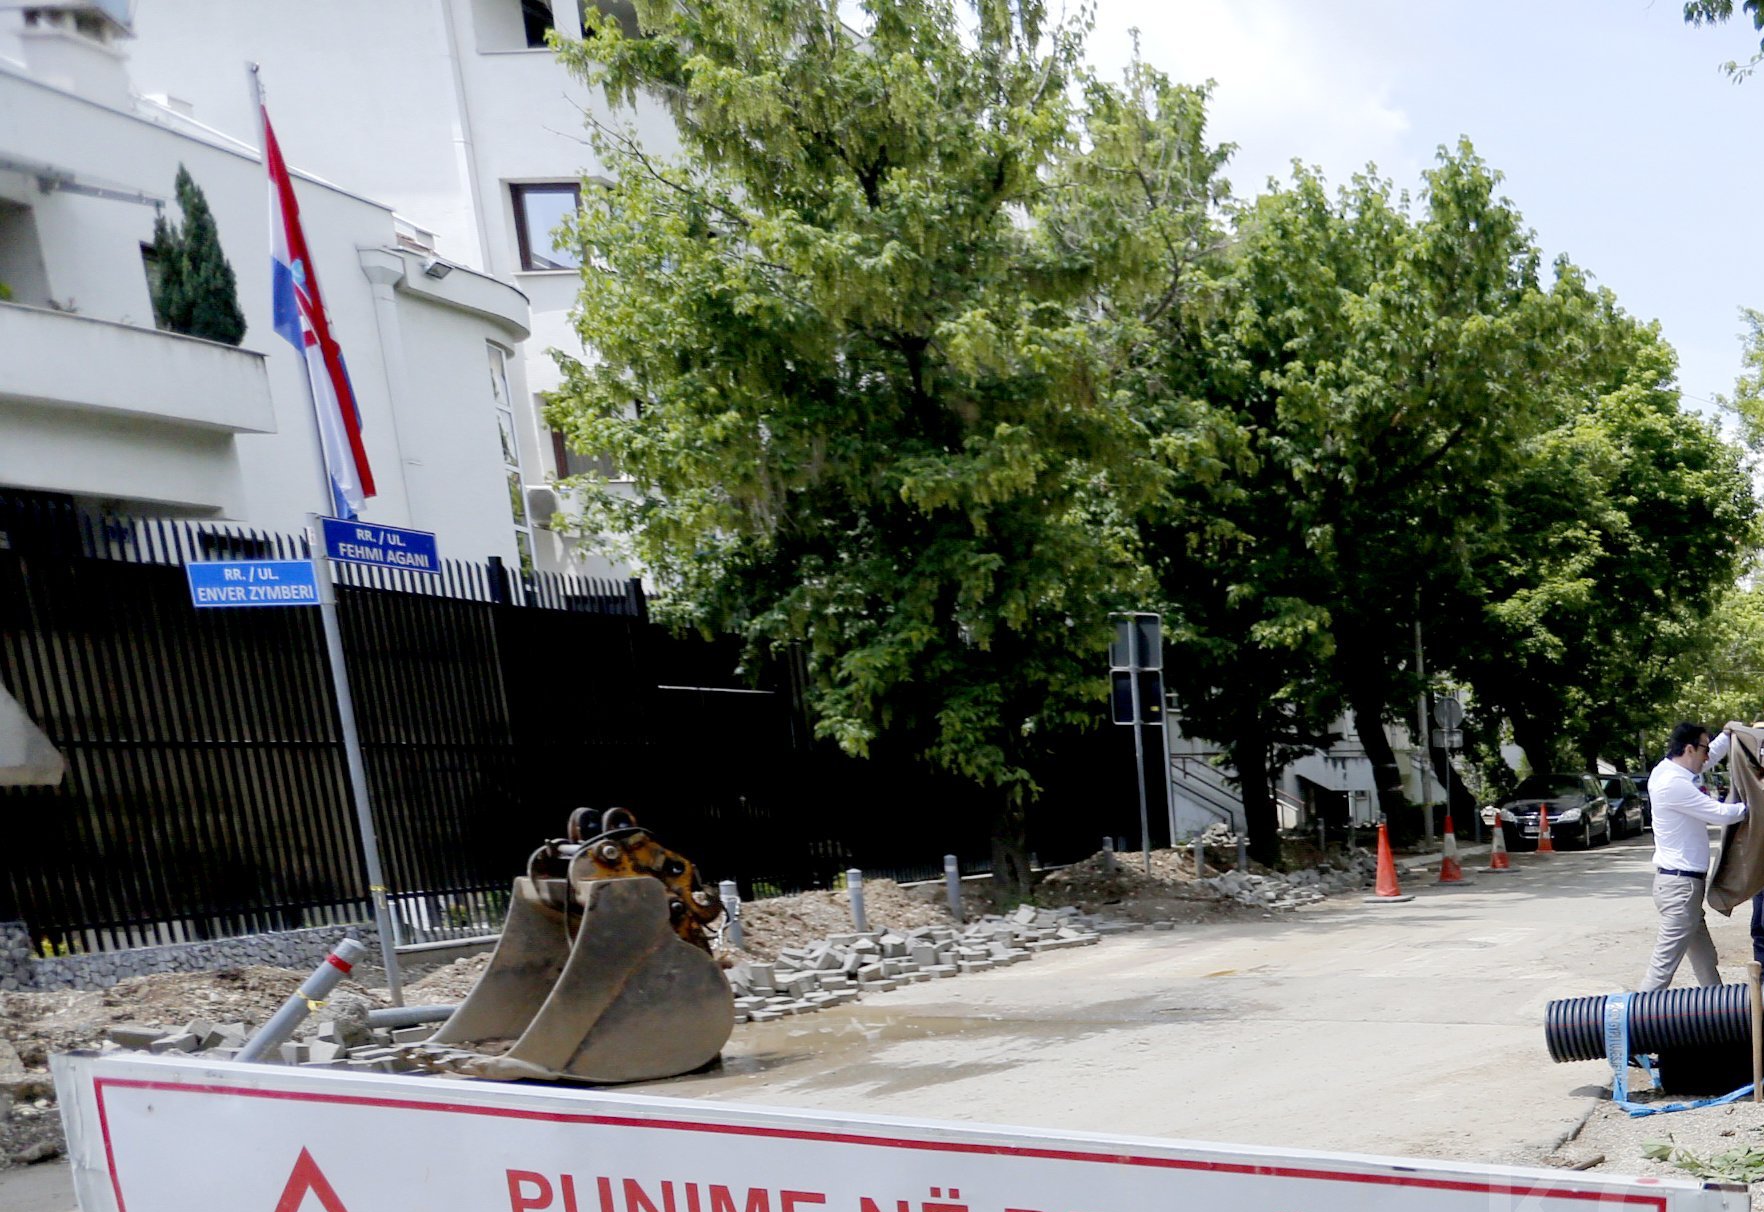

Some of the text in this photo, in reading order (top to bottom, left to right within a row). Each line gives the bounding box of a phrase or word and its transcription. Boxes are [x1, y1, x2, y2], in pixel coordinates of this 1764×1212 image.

[356, 528, 377, 542] RR.
[387, 532, 406, 547] UL.
[338, 542, 429, 568] FEHMI AGANI
[224, 568, 246, 581] RR.
[258, 568, 279, 581] UL.
[197, 585, 314, 602] ENVER ZYMBERI
